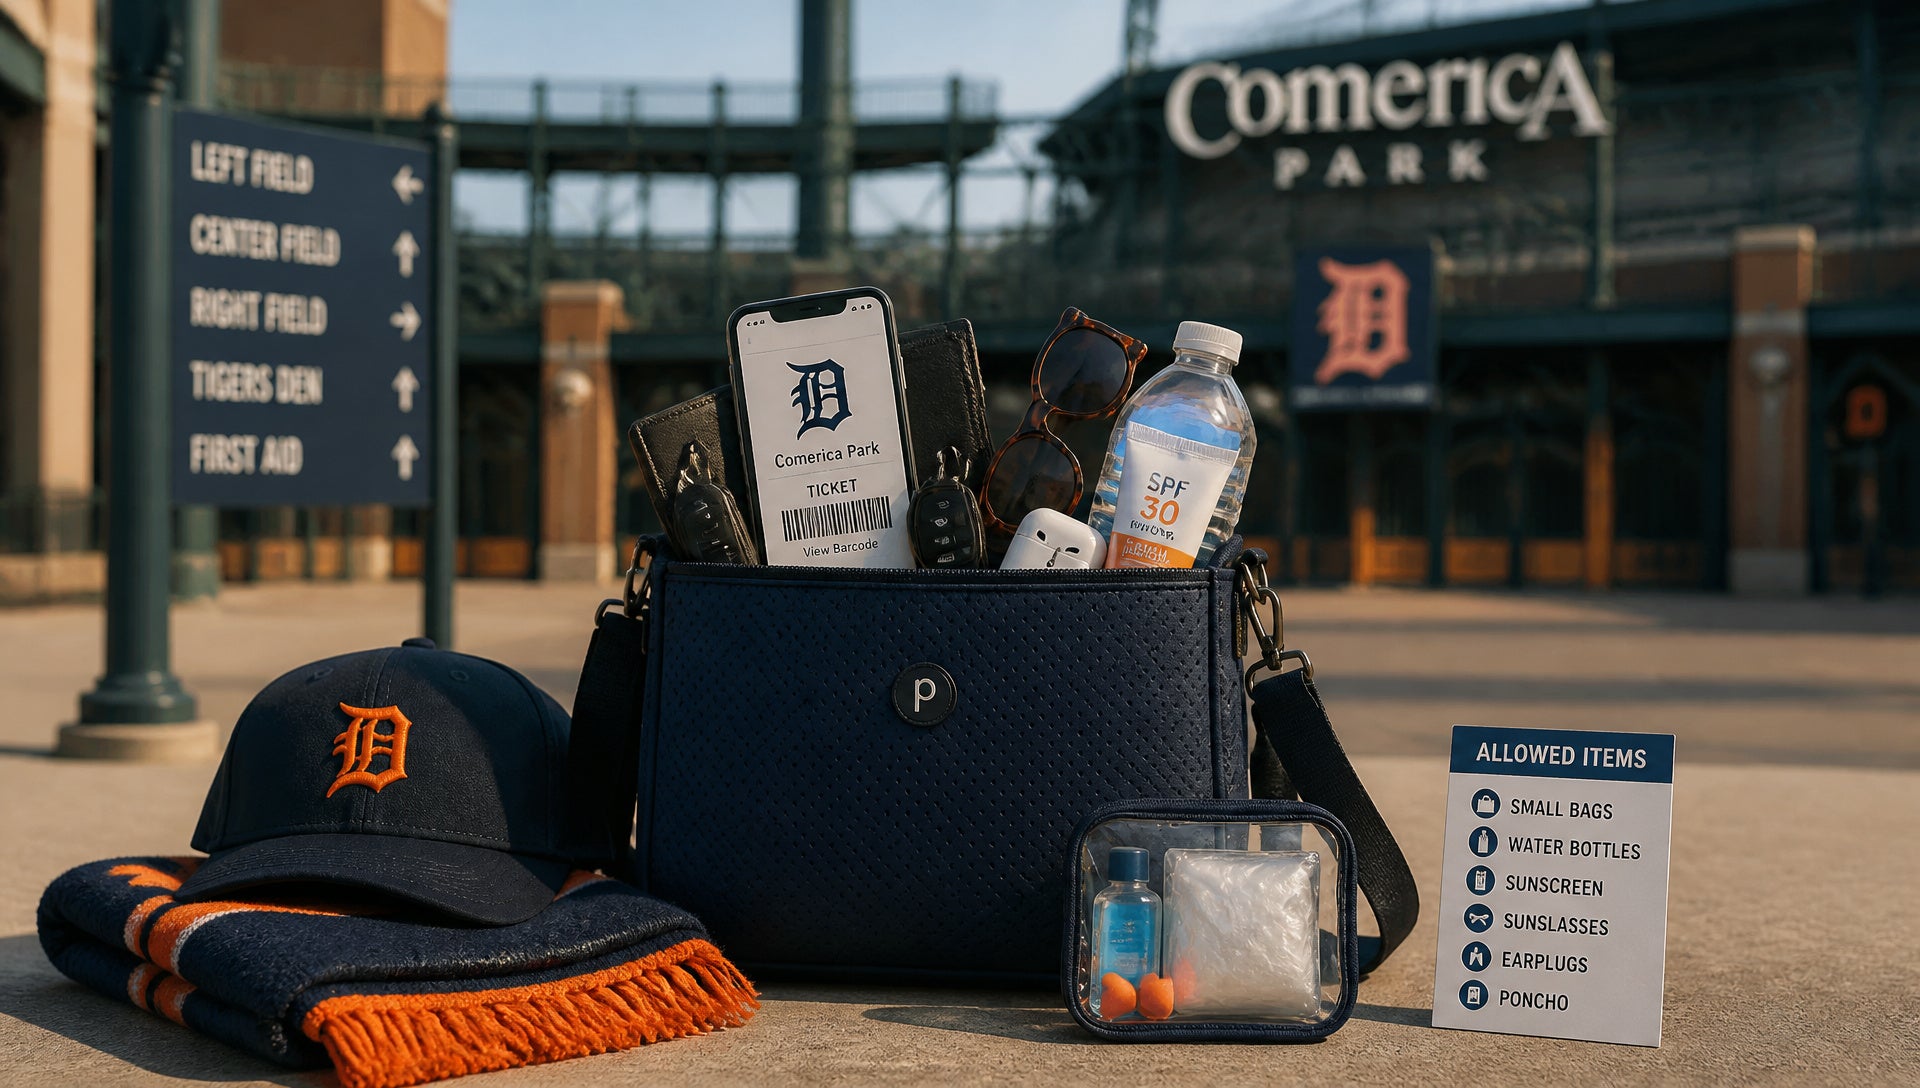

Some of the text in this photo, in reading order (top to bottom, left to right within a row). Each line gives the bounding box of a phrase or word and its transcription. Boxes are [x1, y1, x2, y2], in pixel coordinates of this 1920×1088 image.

[191, 140, 314, 195] LEFT FIELD
[1272, 138, 1488, 190] PARK
[190, 213, 341, 267] CENTER FIELD
[190, 287, 328, 336] RIGHT FIELD
[189, 360, 323, 405] TIGERS DEN
[189, 434, 304, 476] FIRST AID
[775, 441, 880, 469] Comerica Park
[807, 479, 857, 498] TICKET
[1147, 472, 1190, 499] SPF
[1140, 495, 1180, 526] 30
[803, 539, 879, 558] View Barcode
[1475, 742, 1647, 769] ALLOWED ITEMS
[1510, 798, 1613, 820] SMALL BAGS
[1508, 836, 1641, 861] WATER BOTTLES
[1505, 874, 1603, 897] SUNSCREEN
[1503, 913, 1609, 936] SUNSLASSES
[1501, 951, 1588, 973] EARPLUGS
[1499, 990, 1569, 1012] PONCHO
